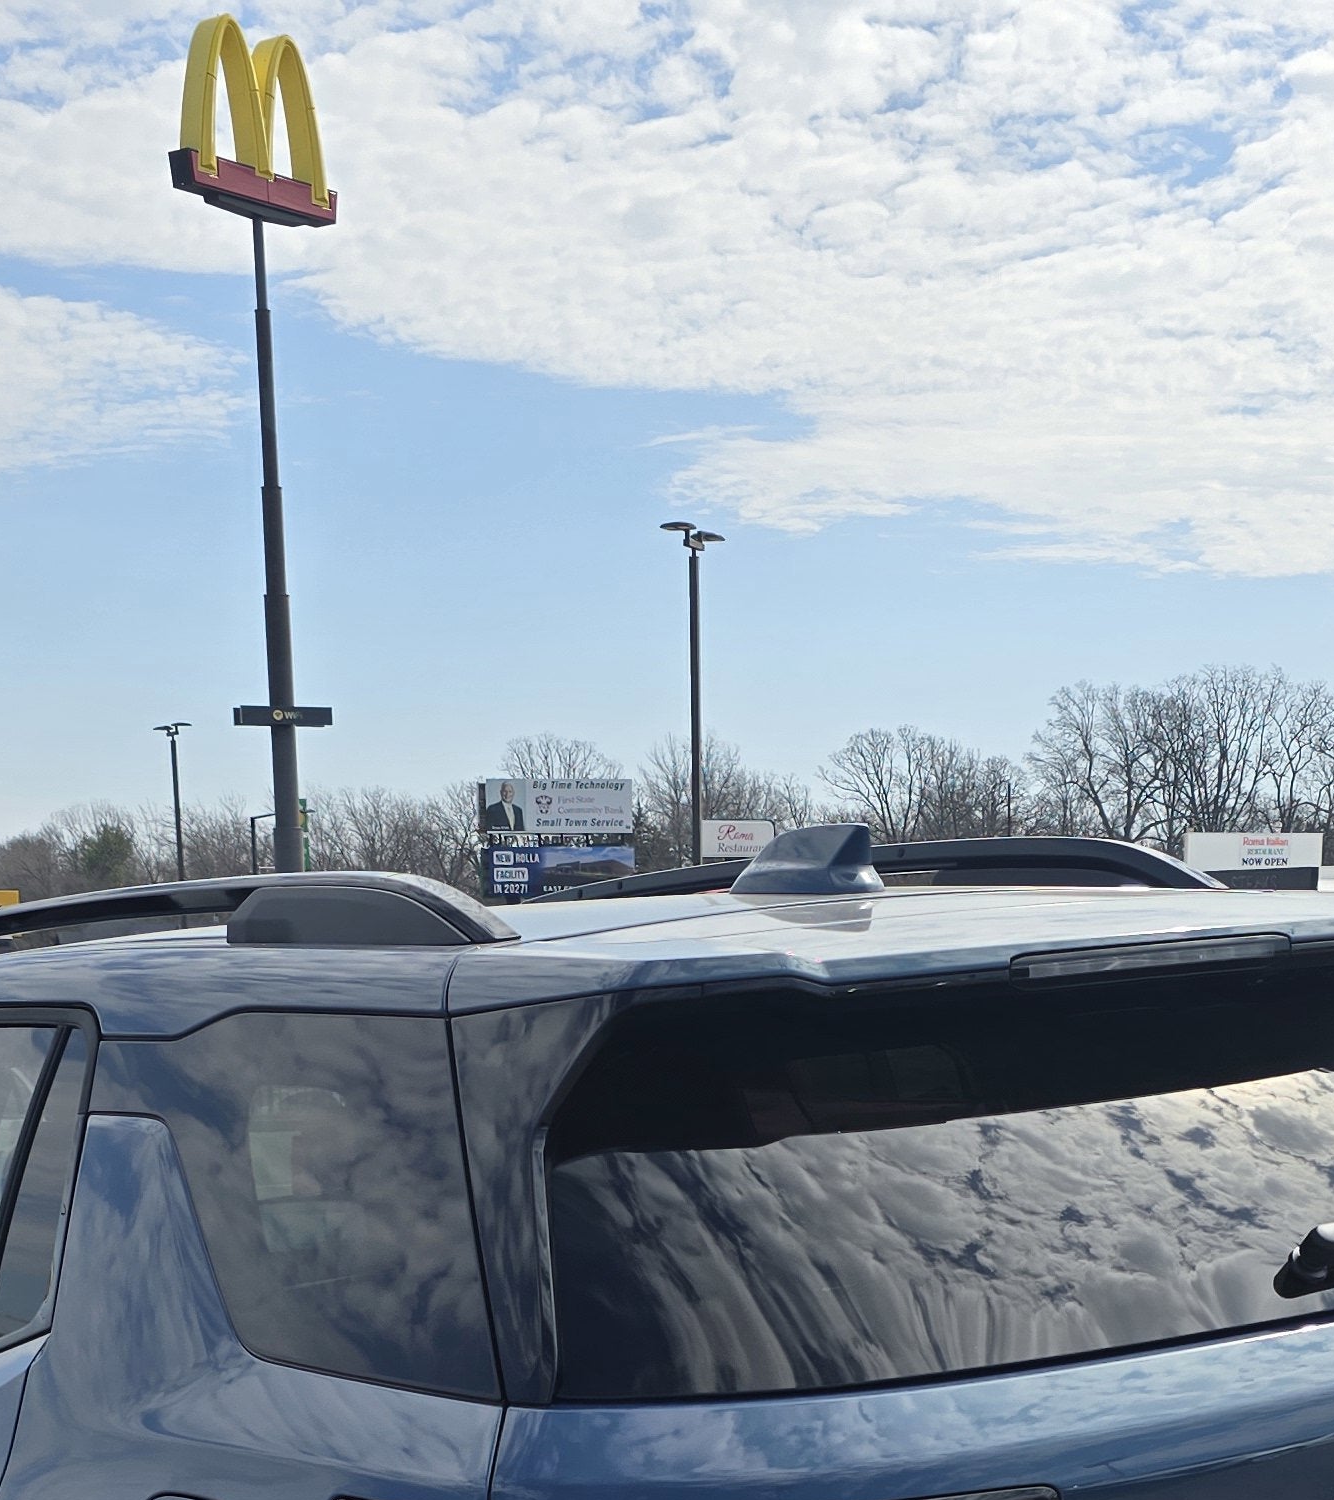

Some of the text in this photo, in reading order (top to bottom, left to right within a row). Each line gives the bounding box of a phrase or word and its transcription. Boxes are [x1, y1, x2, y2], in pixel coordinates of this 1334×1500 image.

[532, 780, 625, 791] Big Time Technology
[557, 796, 595, 804] First State
[557, 806, 624, 815] Community Bank
[535, 818, 624, 827] Small Town Service
[717, 824, 754, 841] Roma
[1242, 836, 1289, 846] Roma Italian
[717, 842, 764, 853] Restauran
[496, 853, 540, 863] NEW ROLLA
[1242, 858, 1289, 866] NOW OPEN
[496, 870, 526, 879] FACILITY
[494, 884, 503, 894] IN
[504, 884, 528, 894] 2027!
